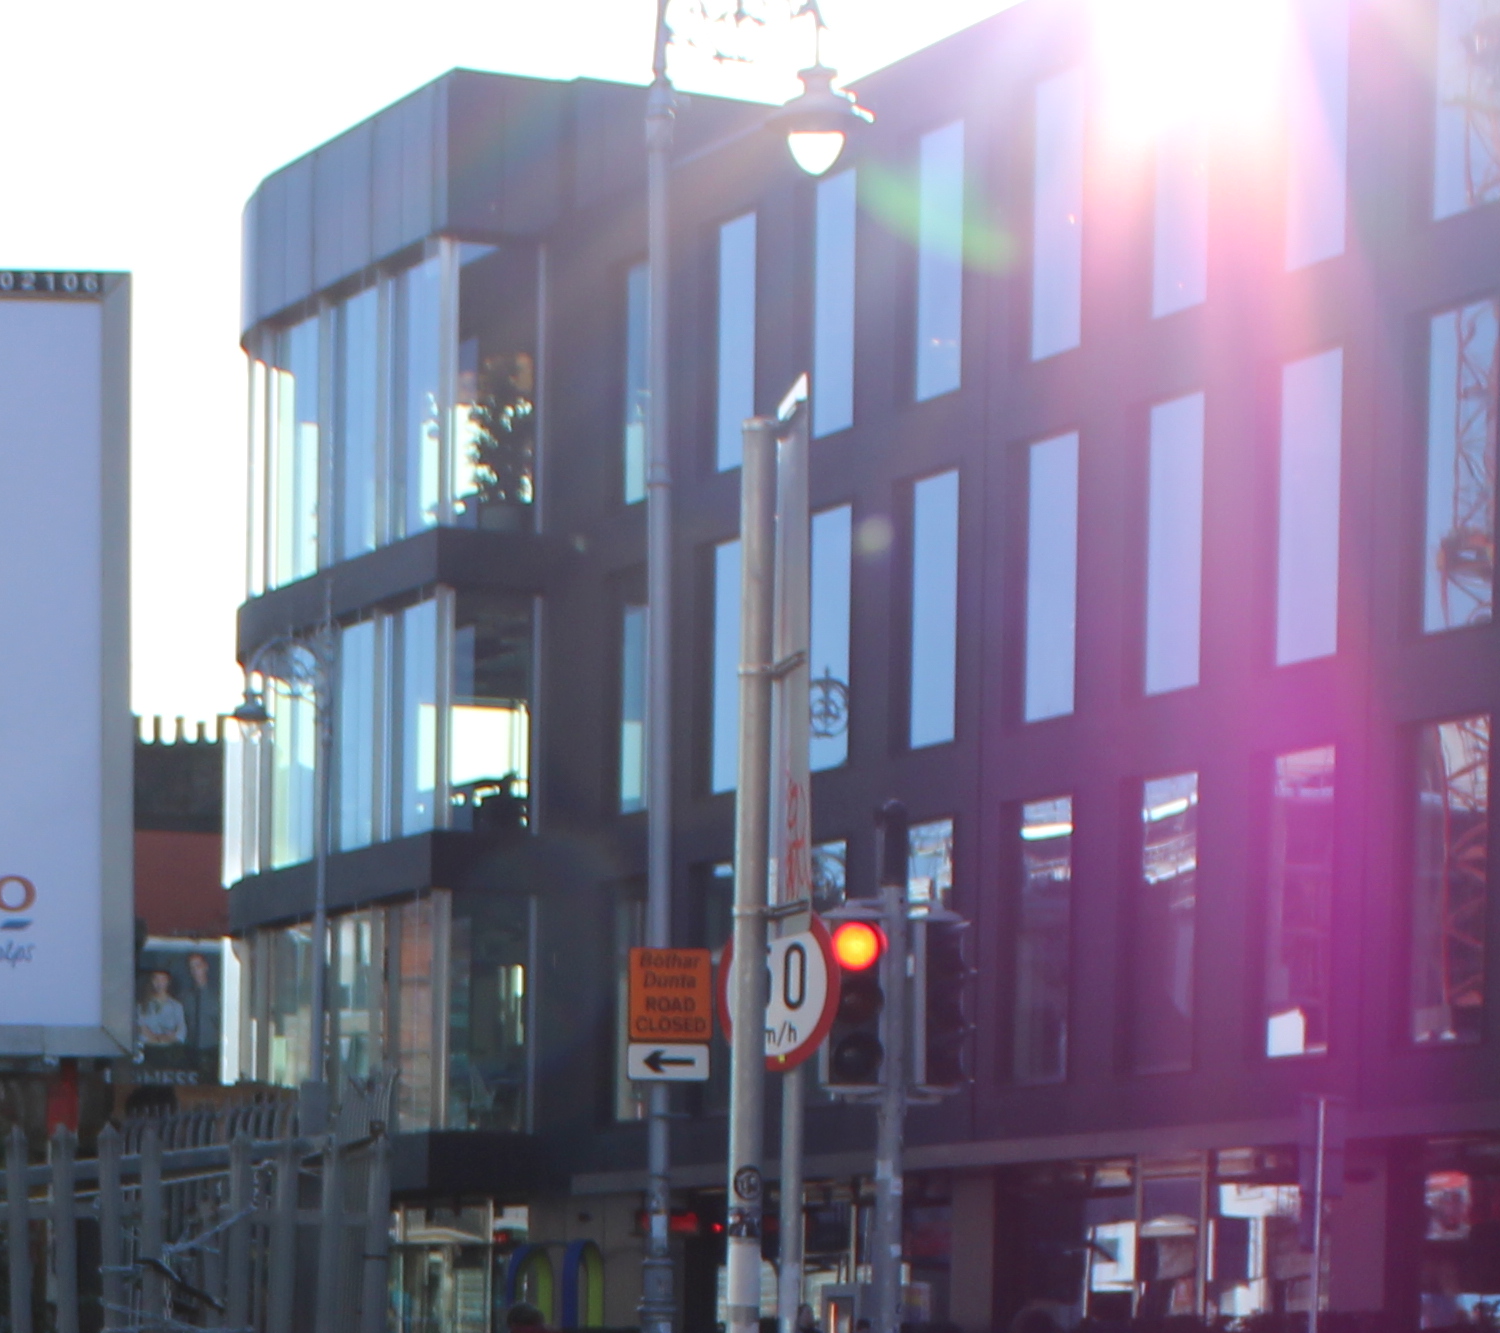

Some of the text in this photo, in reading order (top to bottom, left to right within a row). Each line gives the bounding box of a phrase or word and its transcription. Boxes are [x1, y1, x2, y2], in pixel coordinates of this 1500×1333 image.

[767, 942, 807, 1012] 0
[645, 995, 697, 1012] ROAD
[635, 1015, 706, 1033] CLOSED
